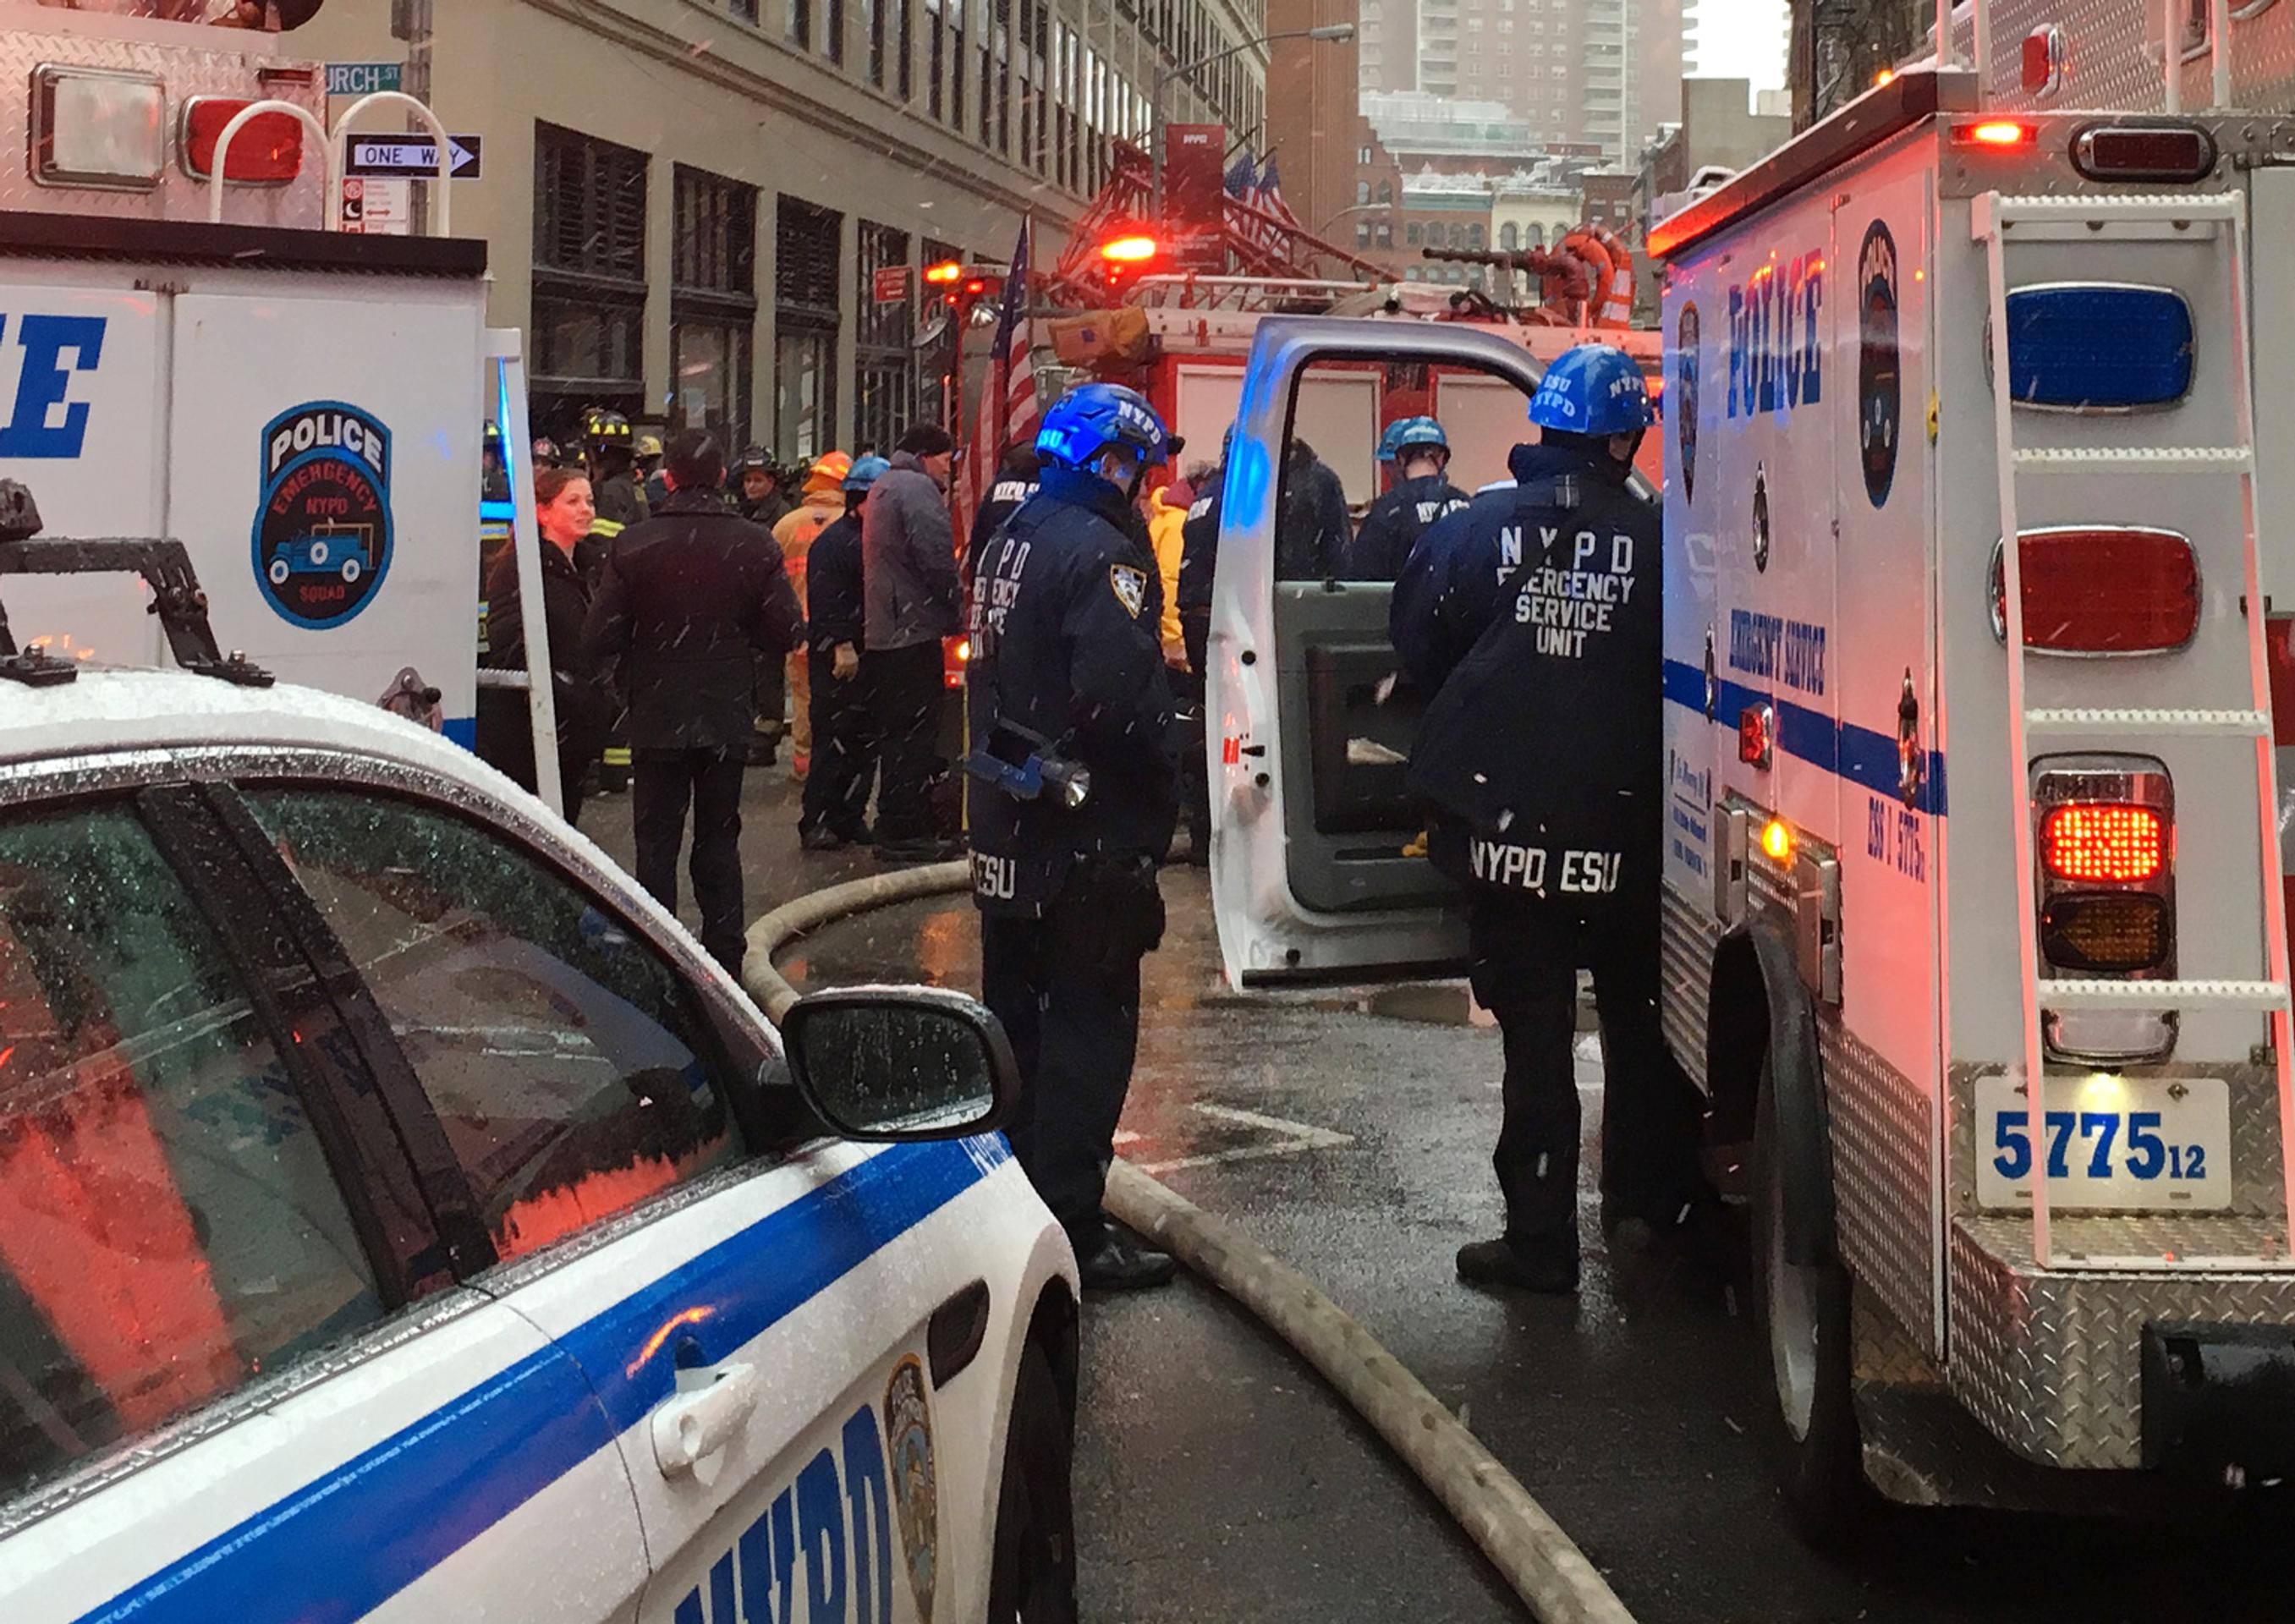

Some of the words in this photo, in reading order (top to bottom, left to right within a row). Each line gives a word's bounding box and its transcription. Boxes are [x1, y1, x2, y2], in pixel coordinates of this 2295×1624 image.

[365, 147, 403, 164] ONE
[421, 148, 460, 164] WY
[1727, 248, 1823, 420] POLICE
[1544, 375, 1572, 392] ESU
[1118, 400, 1161, 445] NYPD
[271, 413, 383, 474] POLICE
[272, 461, 378, 516] EMERGENCY
[306, 497, 349, 515] NYPD
[299, 584, 345, 604] SQUAD
[1515, 594, 1615, 633] SERVICE
[1535, 626, 1588, 659] UNIT
[1469, 837, 1547, 889] NYPD
[1560, 849, 1622, 893] ESU
